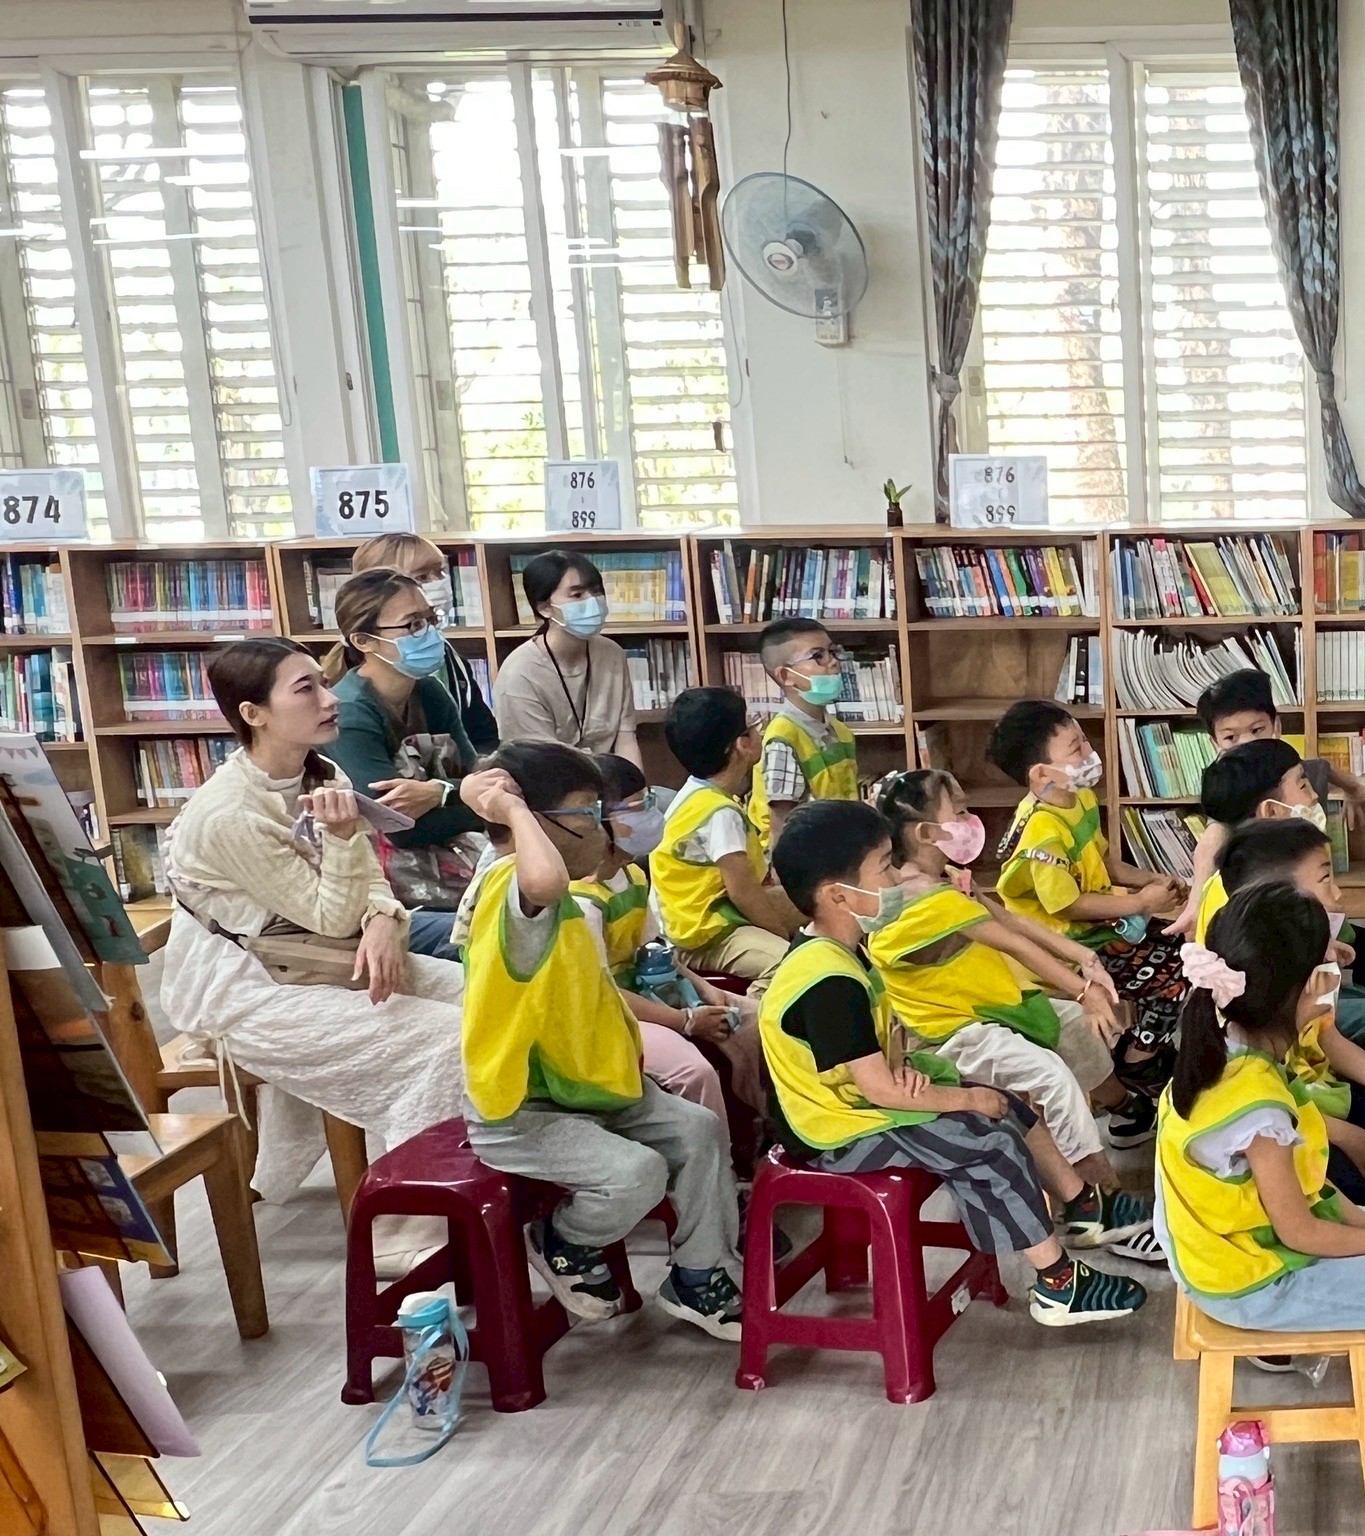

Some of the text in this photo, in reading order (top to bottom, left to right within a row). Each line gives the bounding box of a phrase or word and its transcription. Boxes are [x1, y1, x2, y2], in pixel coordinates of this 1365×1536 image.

[570, 471, 595, 489] 876
[984, 466, 1015, 483] 876
[3, 495, 61, 525] 874
[338, 489, 389, 520] 875
[571, 510, 596, 529] 899
[985, 505, 1016, 523] 899
